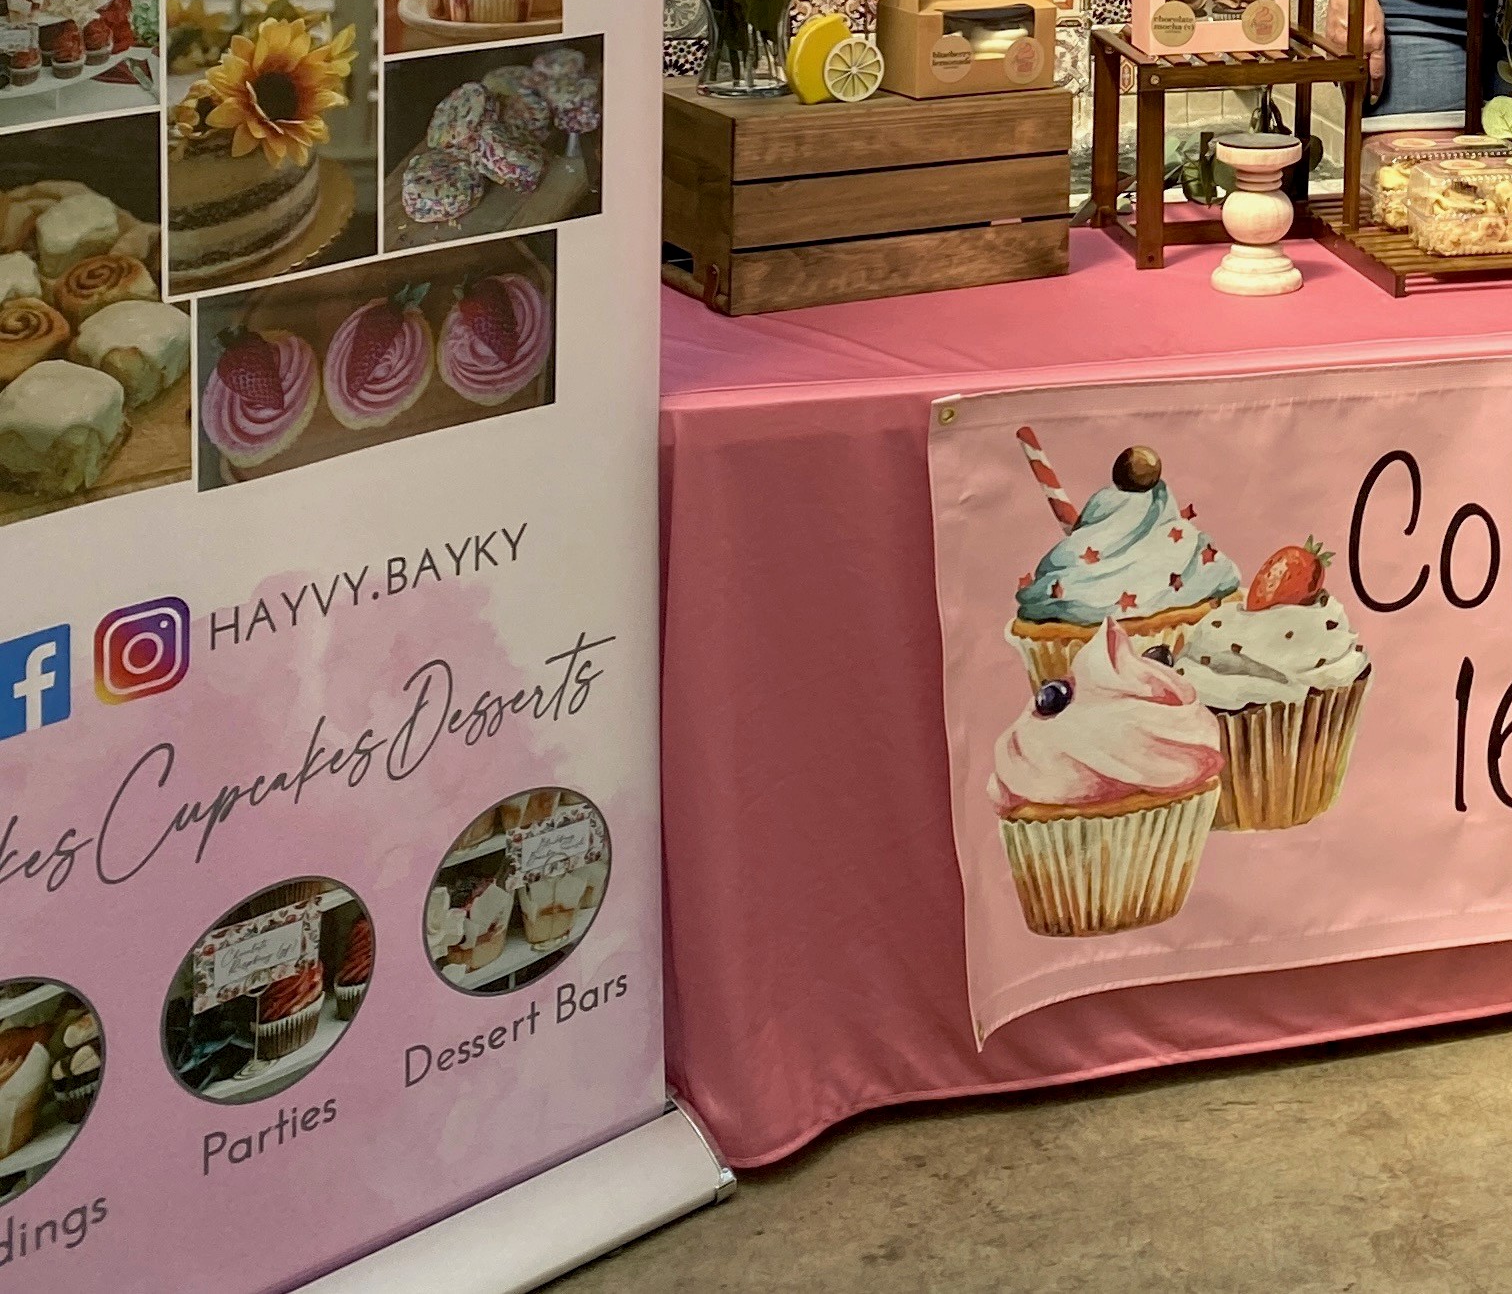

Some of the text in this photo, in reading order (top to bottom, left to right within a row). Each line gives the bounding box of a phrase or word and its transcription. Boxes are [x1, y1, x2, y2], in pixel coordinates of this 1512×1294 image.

[210, 522, 528, 651] HAYVY.BAYKY
[96, 714, 388, 885] Cupcakes
[386, 631, 617, 782] Desserts
[405, 969, 629, 1089] Dessert Bars
[204, 1096, 338, 1176] Parties
